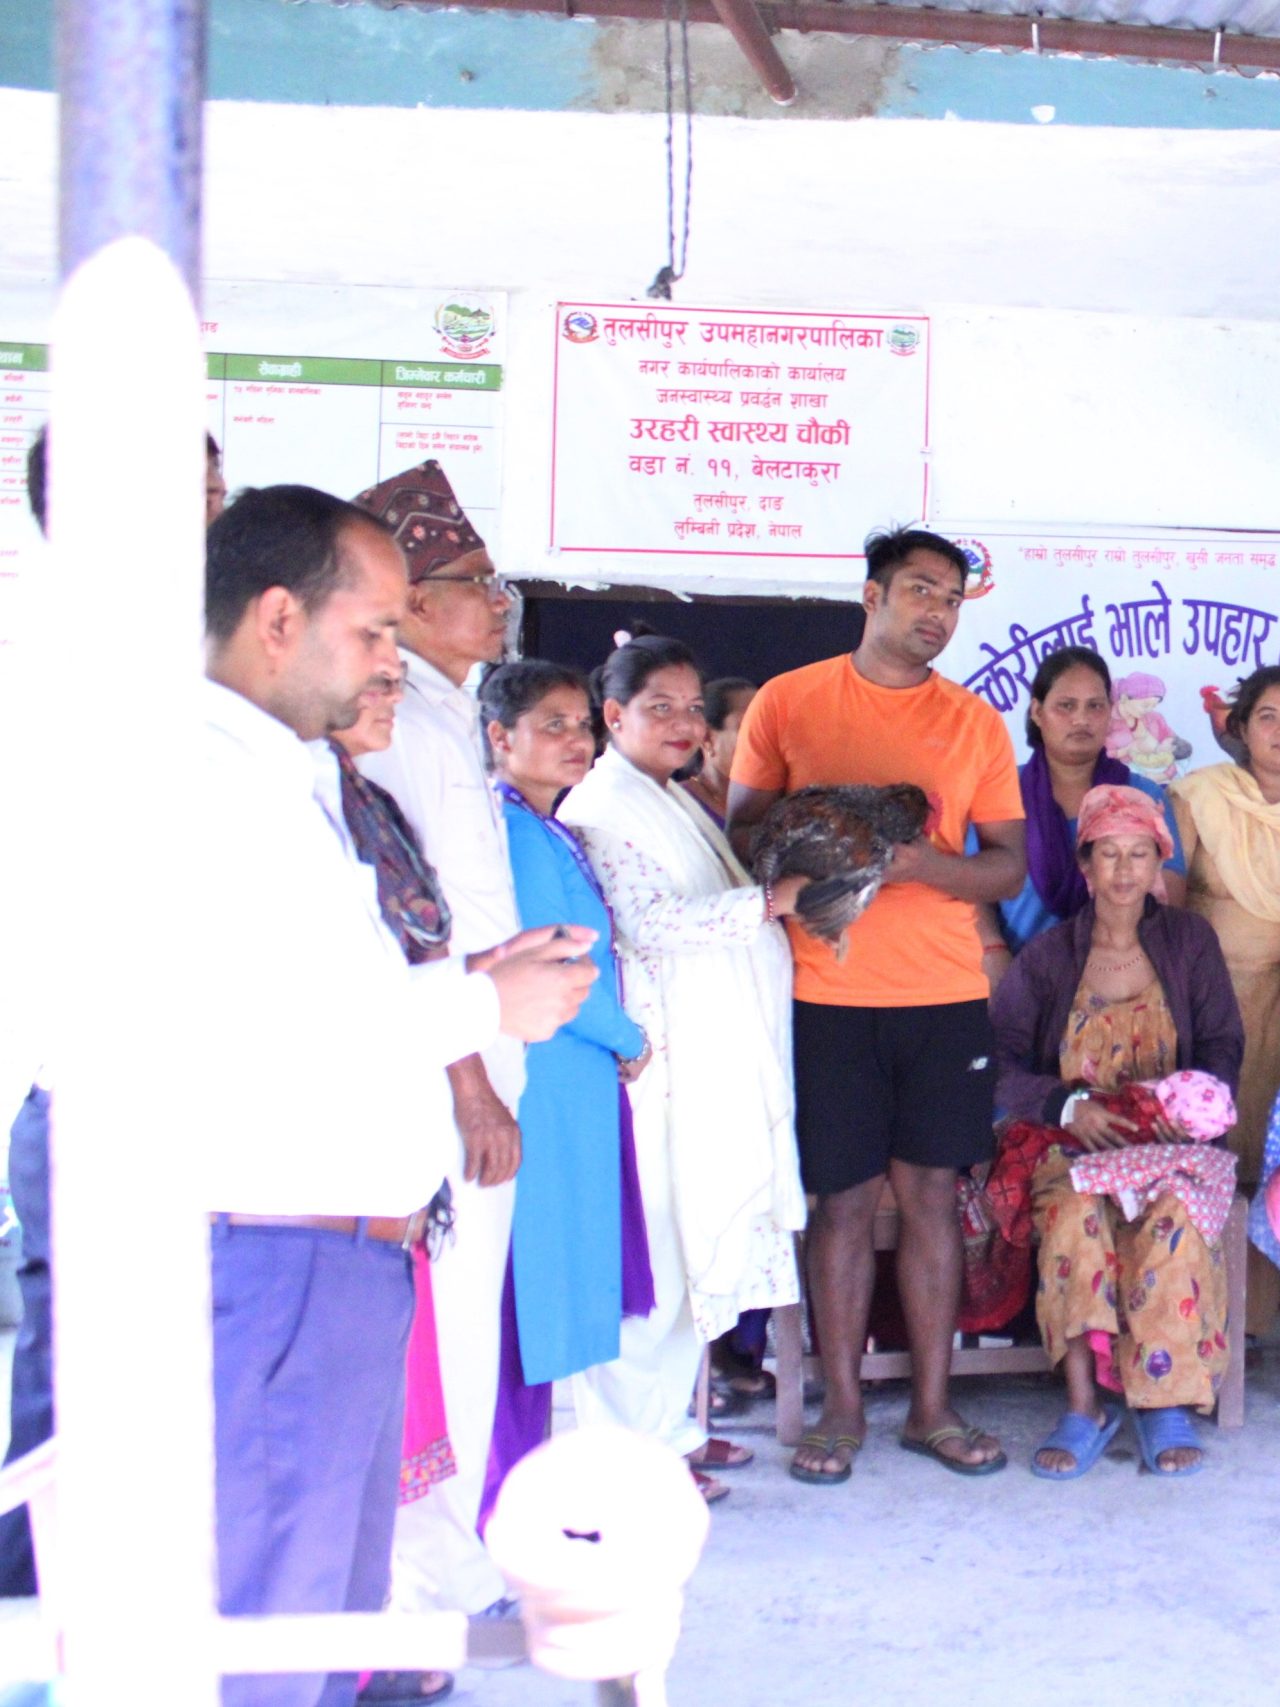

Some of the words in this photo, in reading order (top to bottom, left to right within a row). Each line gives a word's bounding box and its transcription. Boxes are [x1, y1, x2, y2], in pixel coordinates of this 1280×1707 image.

[603, 312, 689, 349] तुलसीपुर
[699, 320, 884, 350] उपमहानगरपालिका
[638, 360, 671, 377] नगर
[678, 358, 780, 380] कार्यपालिकाको
[788, 362, 847, 382] कार्यालय
[657, 389, 733, 405] जनस्वास्थ्य
[790, 393, 829, 409] शाखा
[630, 414, 699, 441] उरहरी
[708, 420, 789, 444] स्वास्थ्य
[797, 417, 851, 446] चौकी
[629, 456, 666, 475] वडा
[676, 453, 695, 476] नं.
[752, 455, 841, 487] बेलटाकुरा
[674, 517, 720, 540] लुम्बिनी
[768, 520, 803, 539] नेपाल
[1054, 544, 1098, 568] तुलसीपुर
[1214, 552, 1244, 566] जनता
[1105, 580, 1172, 659] भाले
[1182, 598, 1279, 670] उपहार
